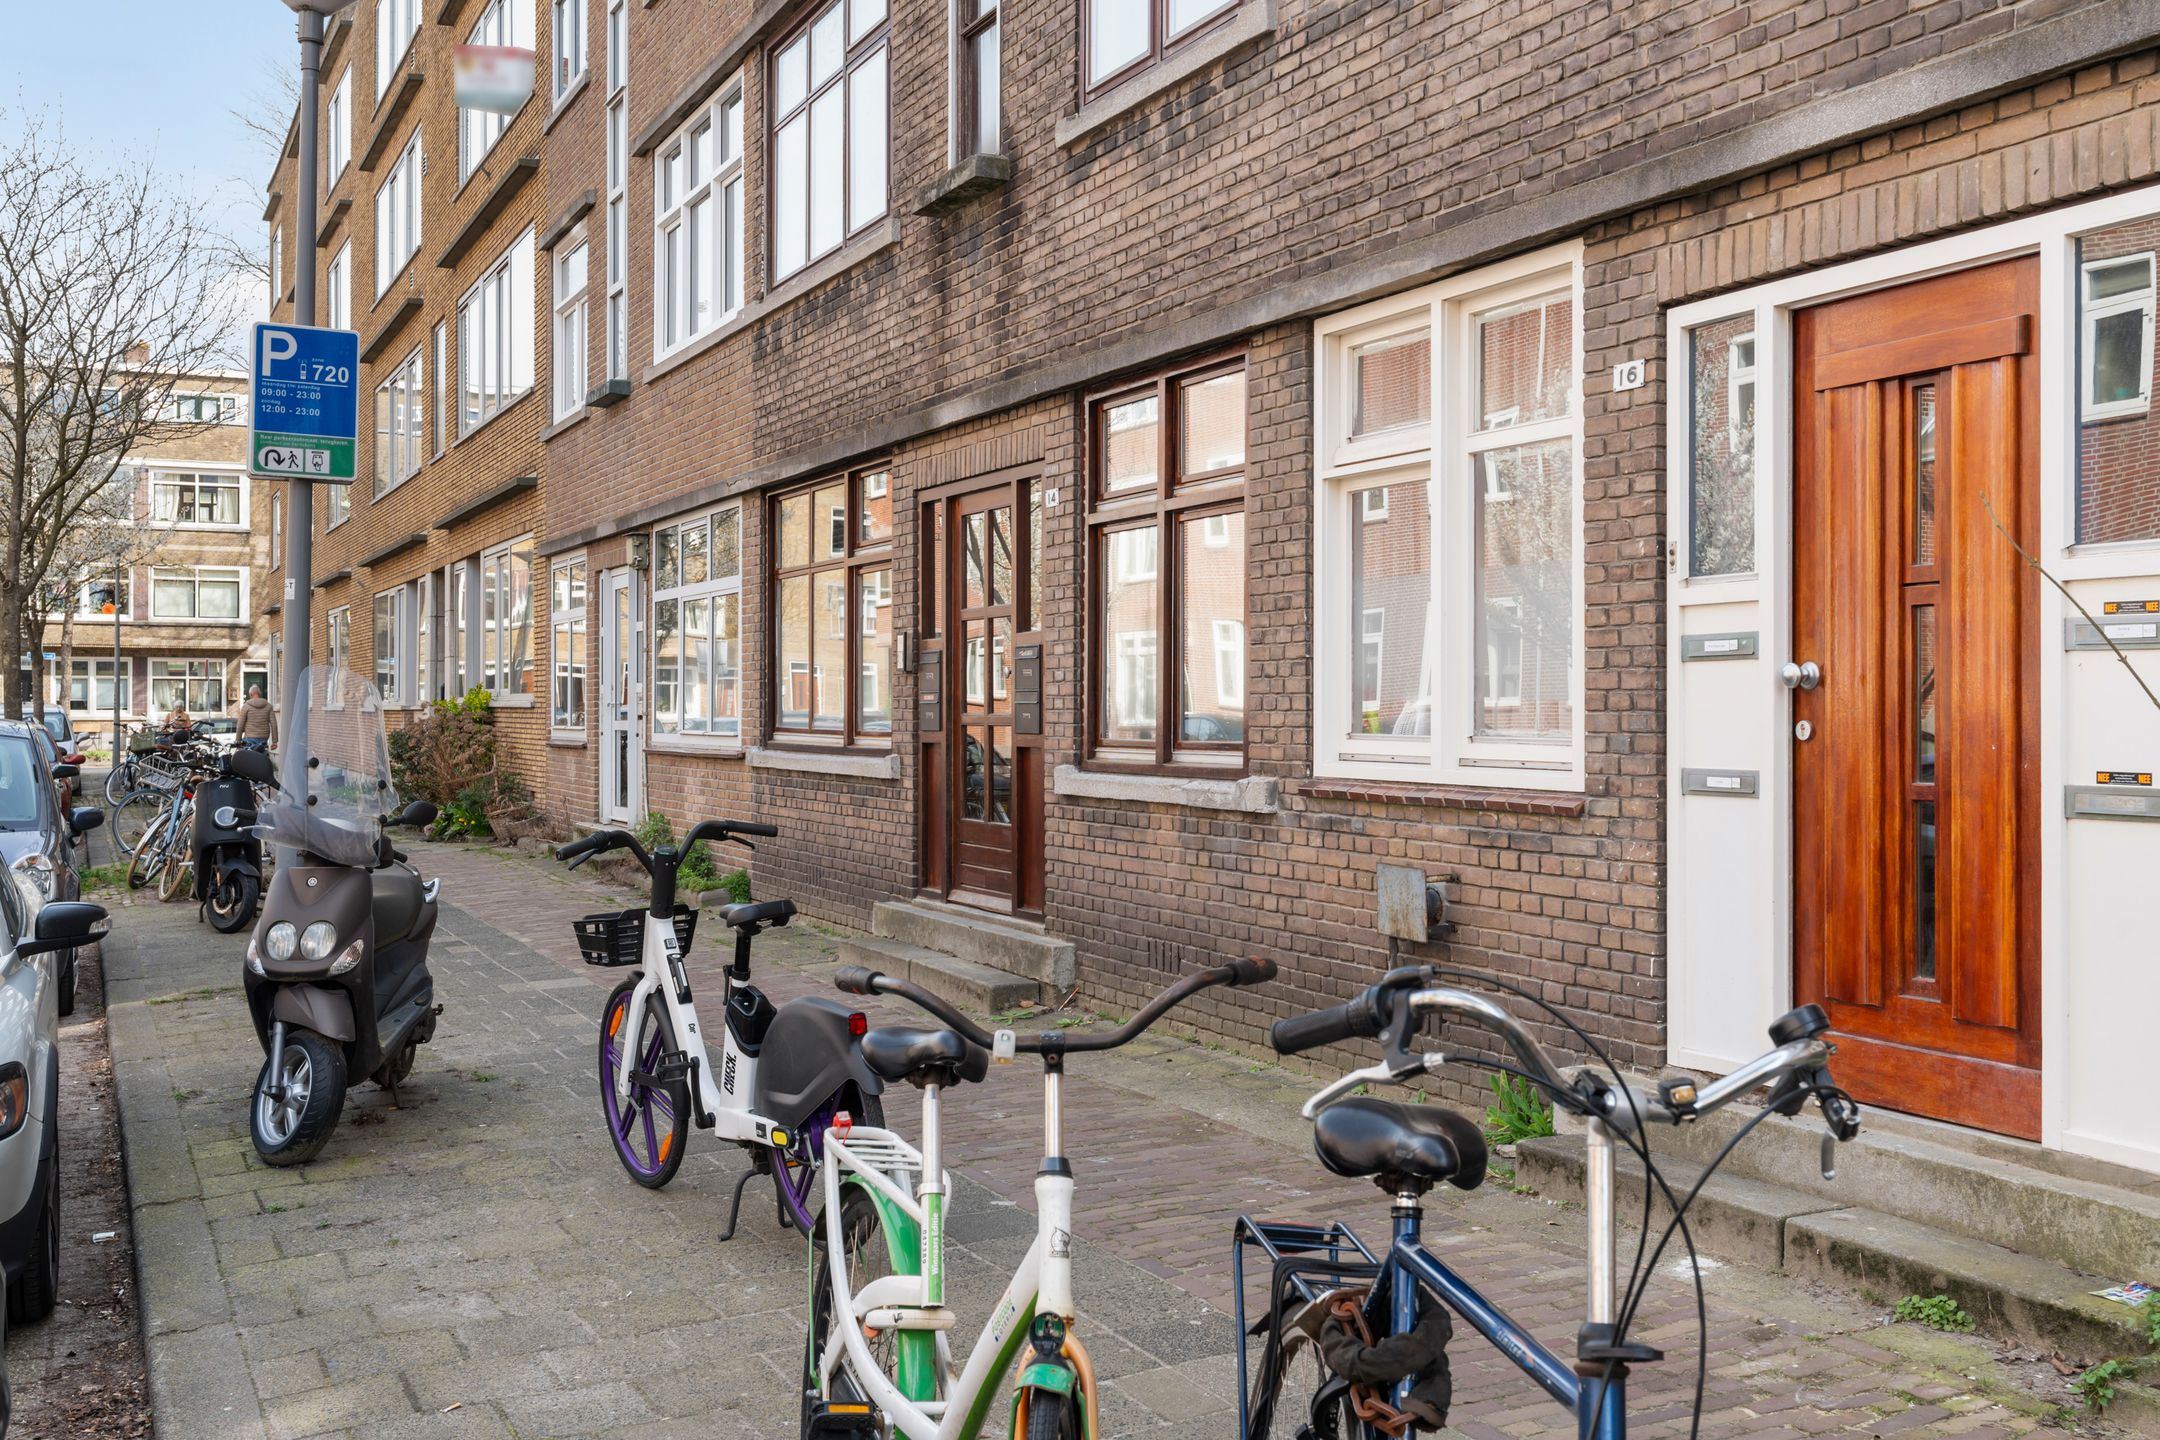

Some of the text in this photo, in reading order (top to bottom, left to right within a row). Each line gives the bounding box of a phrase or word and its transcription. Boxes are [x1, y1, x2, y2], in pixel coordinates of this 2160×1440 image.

[262, 329, 298, 377] P
[312, 364, 349, 383] 720
[1620, 366, 1637, 387] 16
[261, 388, 287, 397] 09:00
[296, 390, 321, 399] 23:00
[261, 404, 286, 413] 12:00
[295, 407, 320, 416] 23:00
[1047, 491, 1056, 505] 14
[2104, 602, 2118, 613] NEE
[2145, 601, 2159, 612] NEE
[2097, 772, 2110, 783] NEE
[2138, 774, 2151, 784] NEE
[931, 1212, 939, 1276] Winnaars Editie
